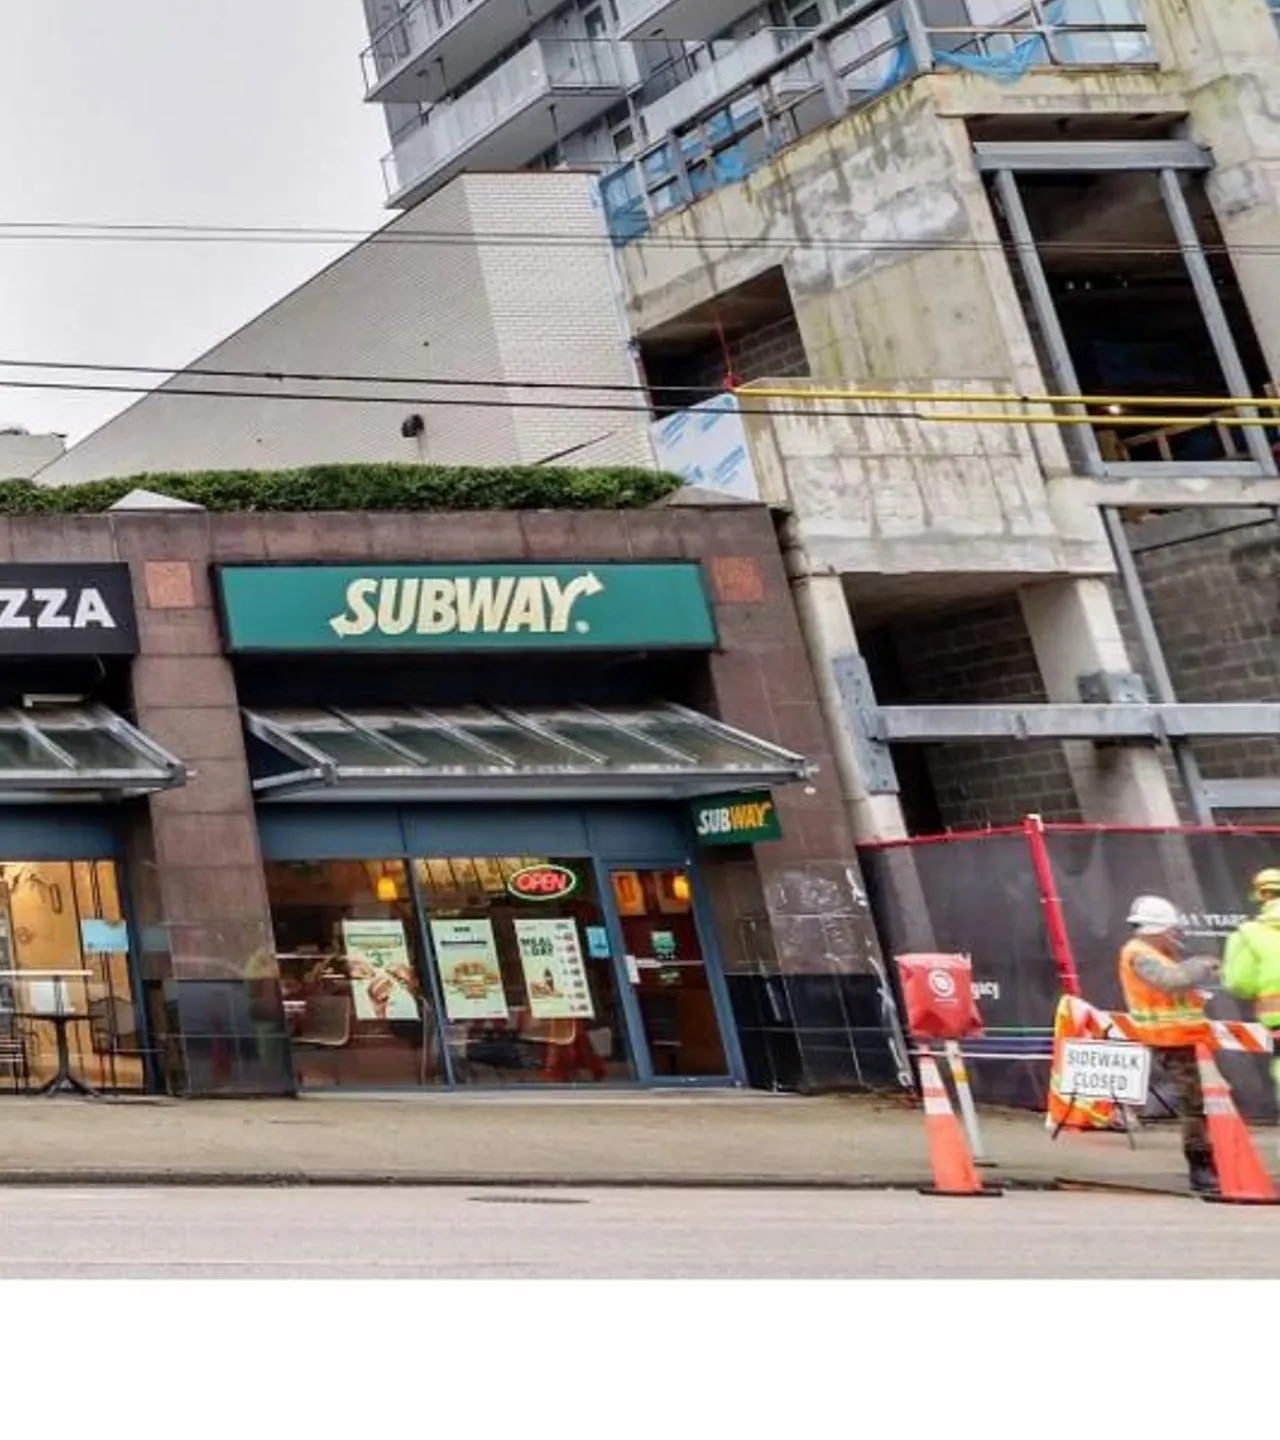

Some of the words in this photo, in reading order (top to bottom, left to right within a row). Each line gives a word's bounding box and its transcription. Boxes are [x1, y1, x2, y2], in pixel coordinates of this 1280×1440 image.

[329, 570, 603, 639] SUBWAY
[696, 801, 773, 836] SUBWAY
[515, 871, 567, 893] OPEN
[1067, 1049, 1140, 1071] SIDEWALK
[1072, 1071, 1128, 1091] CLOSED
